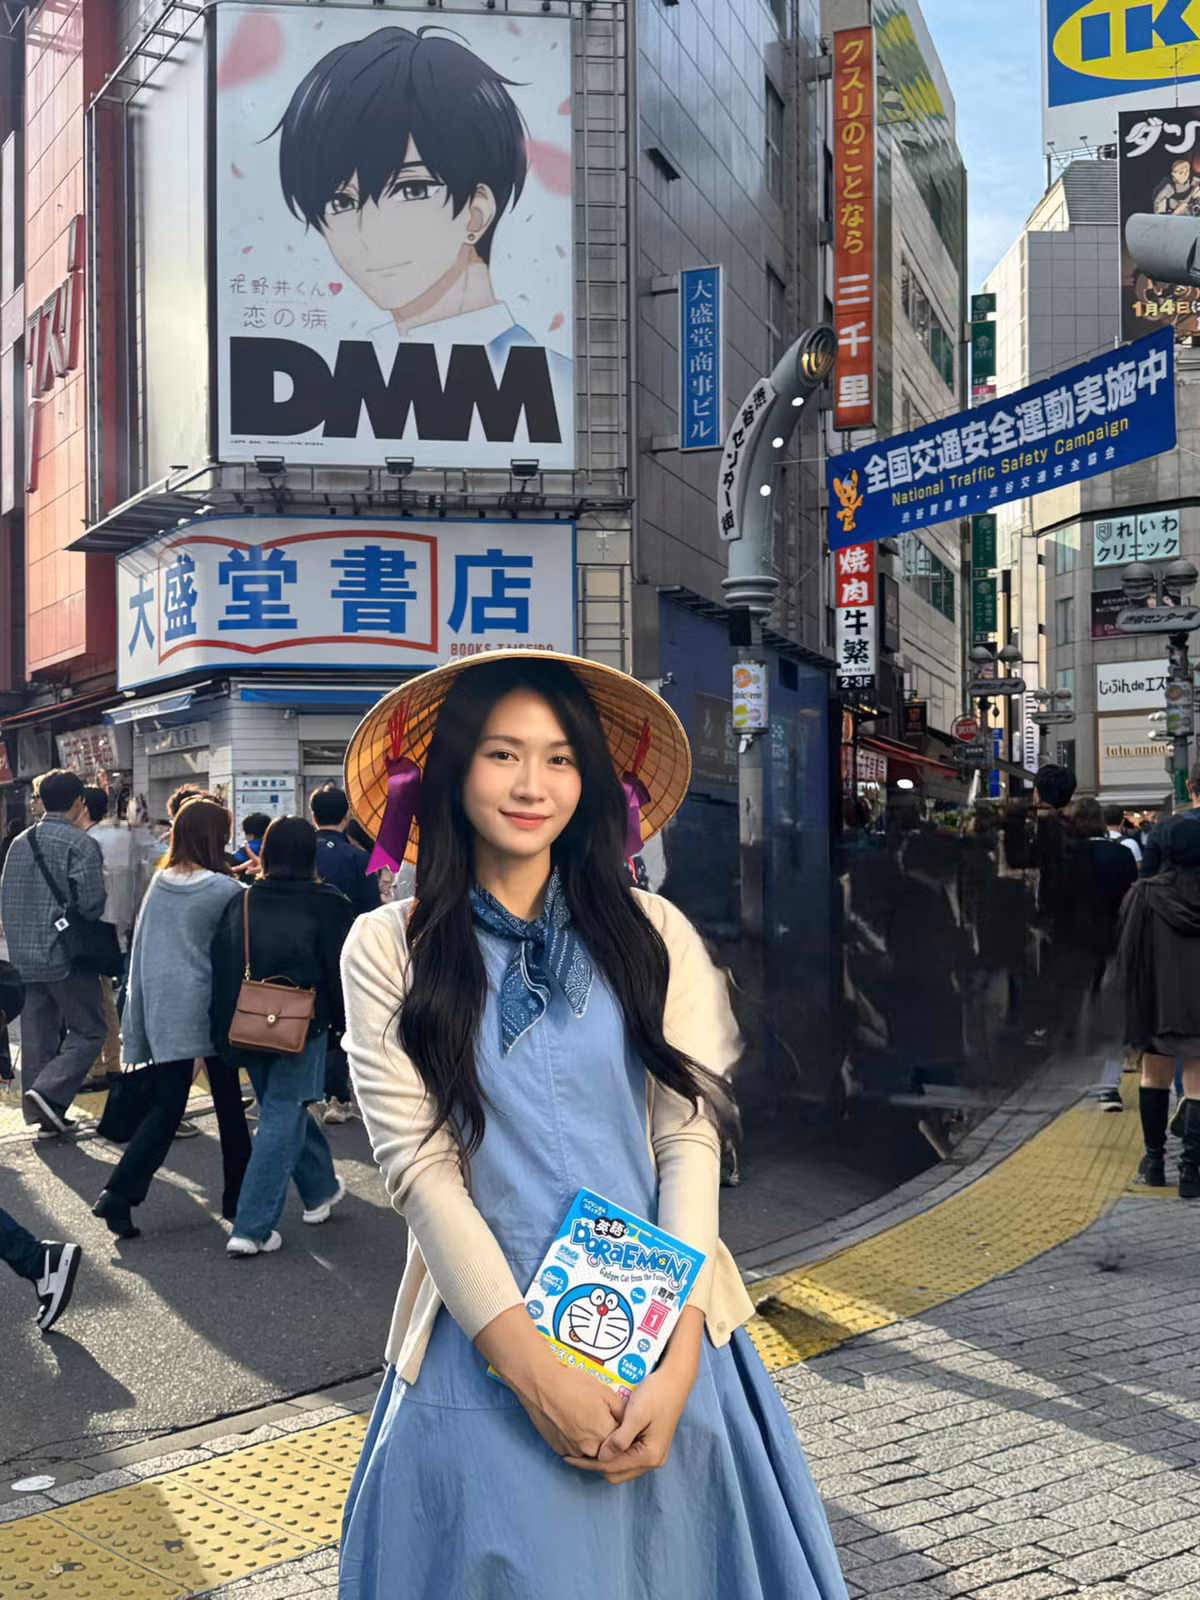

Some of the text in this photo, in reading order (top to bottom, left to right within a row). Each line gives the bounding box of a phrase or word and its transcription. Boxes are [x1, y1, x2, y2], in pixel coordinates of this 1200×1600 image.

[841, 40, 865, 255] クスリのことなら
[229, 274, 327, 297] 花野井くん
[243, 305, 328, 330] 恋の病
[837, 273, 871, 407] 三千里
[690, 279, 713, 438] 大盛堂商事ビル
[230, 336, 562, 443] DMM
[864, 348, 1168, 494] 全国交通安全運動実施中
[721, 386, 768, 536] 渋谷センター街
[892, 417, 1129, 506] National Traffic Safety Campaign
[1097, 538, 1178, 562] クリニック
[1116, 515, 1178, 539] れいわ
[129, 545, 533, 657] 大盛堂書店
[839, 546, 870, 604] 焼肉
[451, 643, 491, 656] BOOKS
[843, 609, 869, 664] 牛繁
[594, 1218, 625, 1238] 英語
[620, 1274, 630, 1282] Cat
[630, 1273, 643, 1282] from
[643, 1272, 652, 1281] the
[648, 1313, 659, 1328] 1
[621, 1357, 637, 1372] Take
